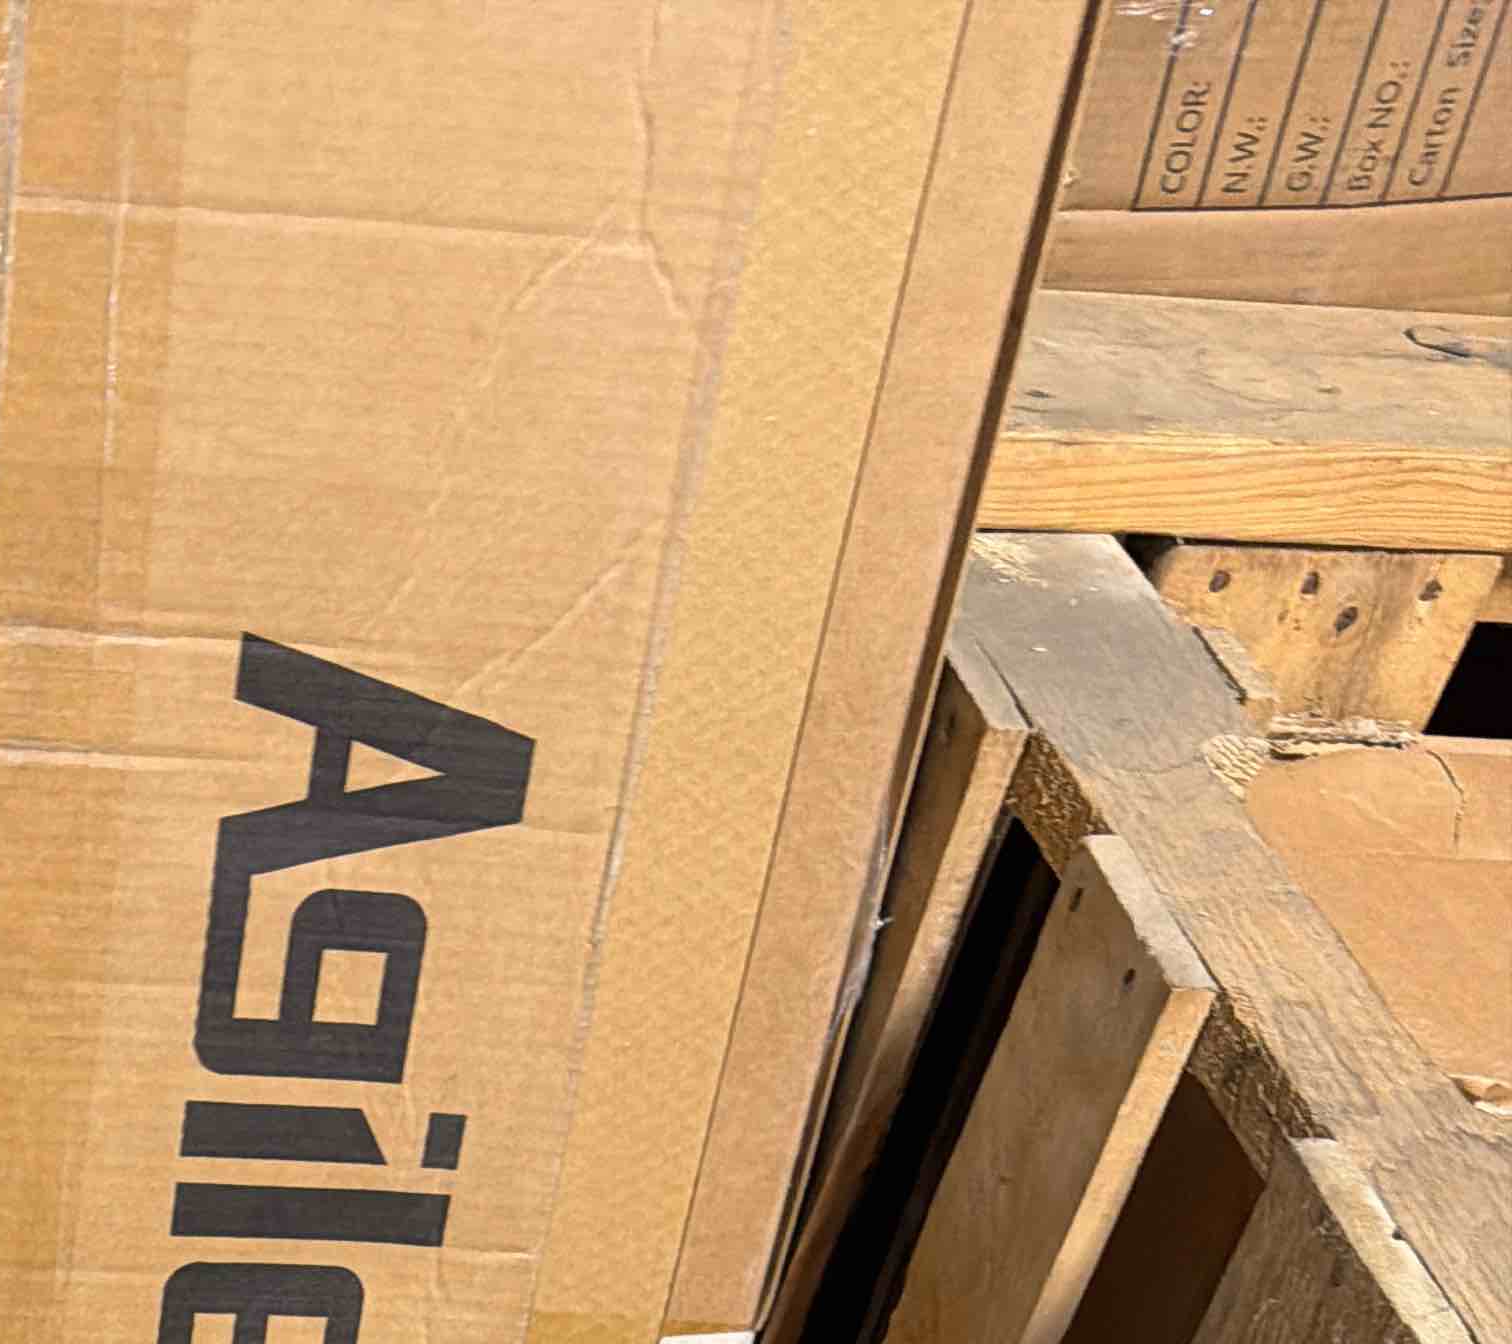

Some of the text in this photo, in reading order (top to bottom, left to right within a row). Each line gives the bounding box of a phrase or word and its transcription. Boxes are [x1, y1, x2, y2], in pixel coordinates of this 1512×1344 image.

[1160, 81, 1212, 193] COLOR:
[1347, 139, 1386, 190] Box
[1408, 87, 1462, 185] Carton
